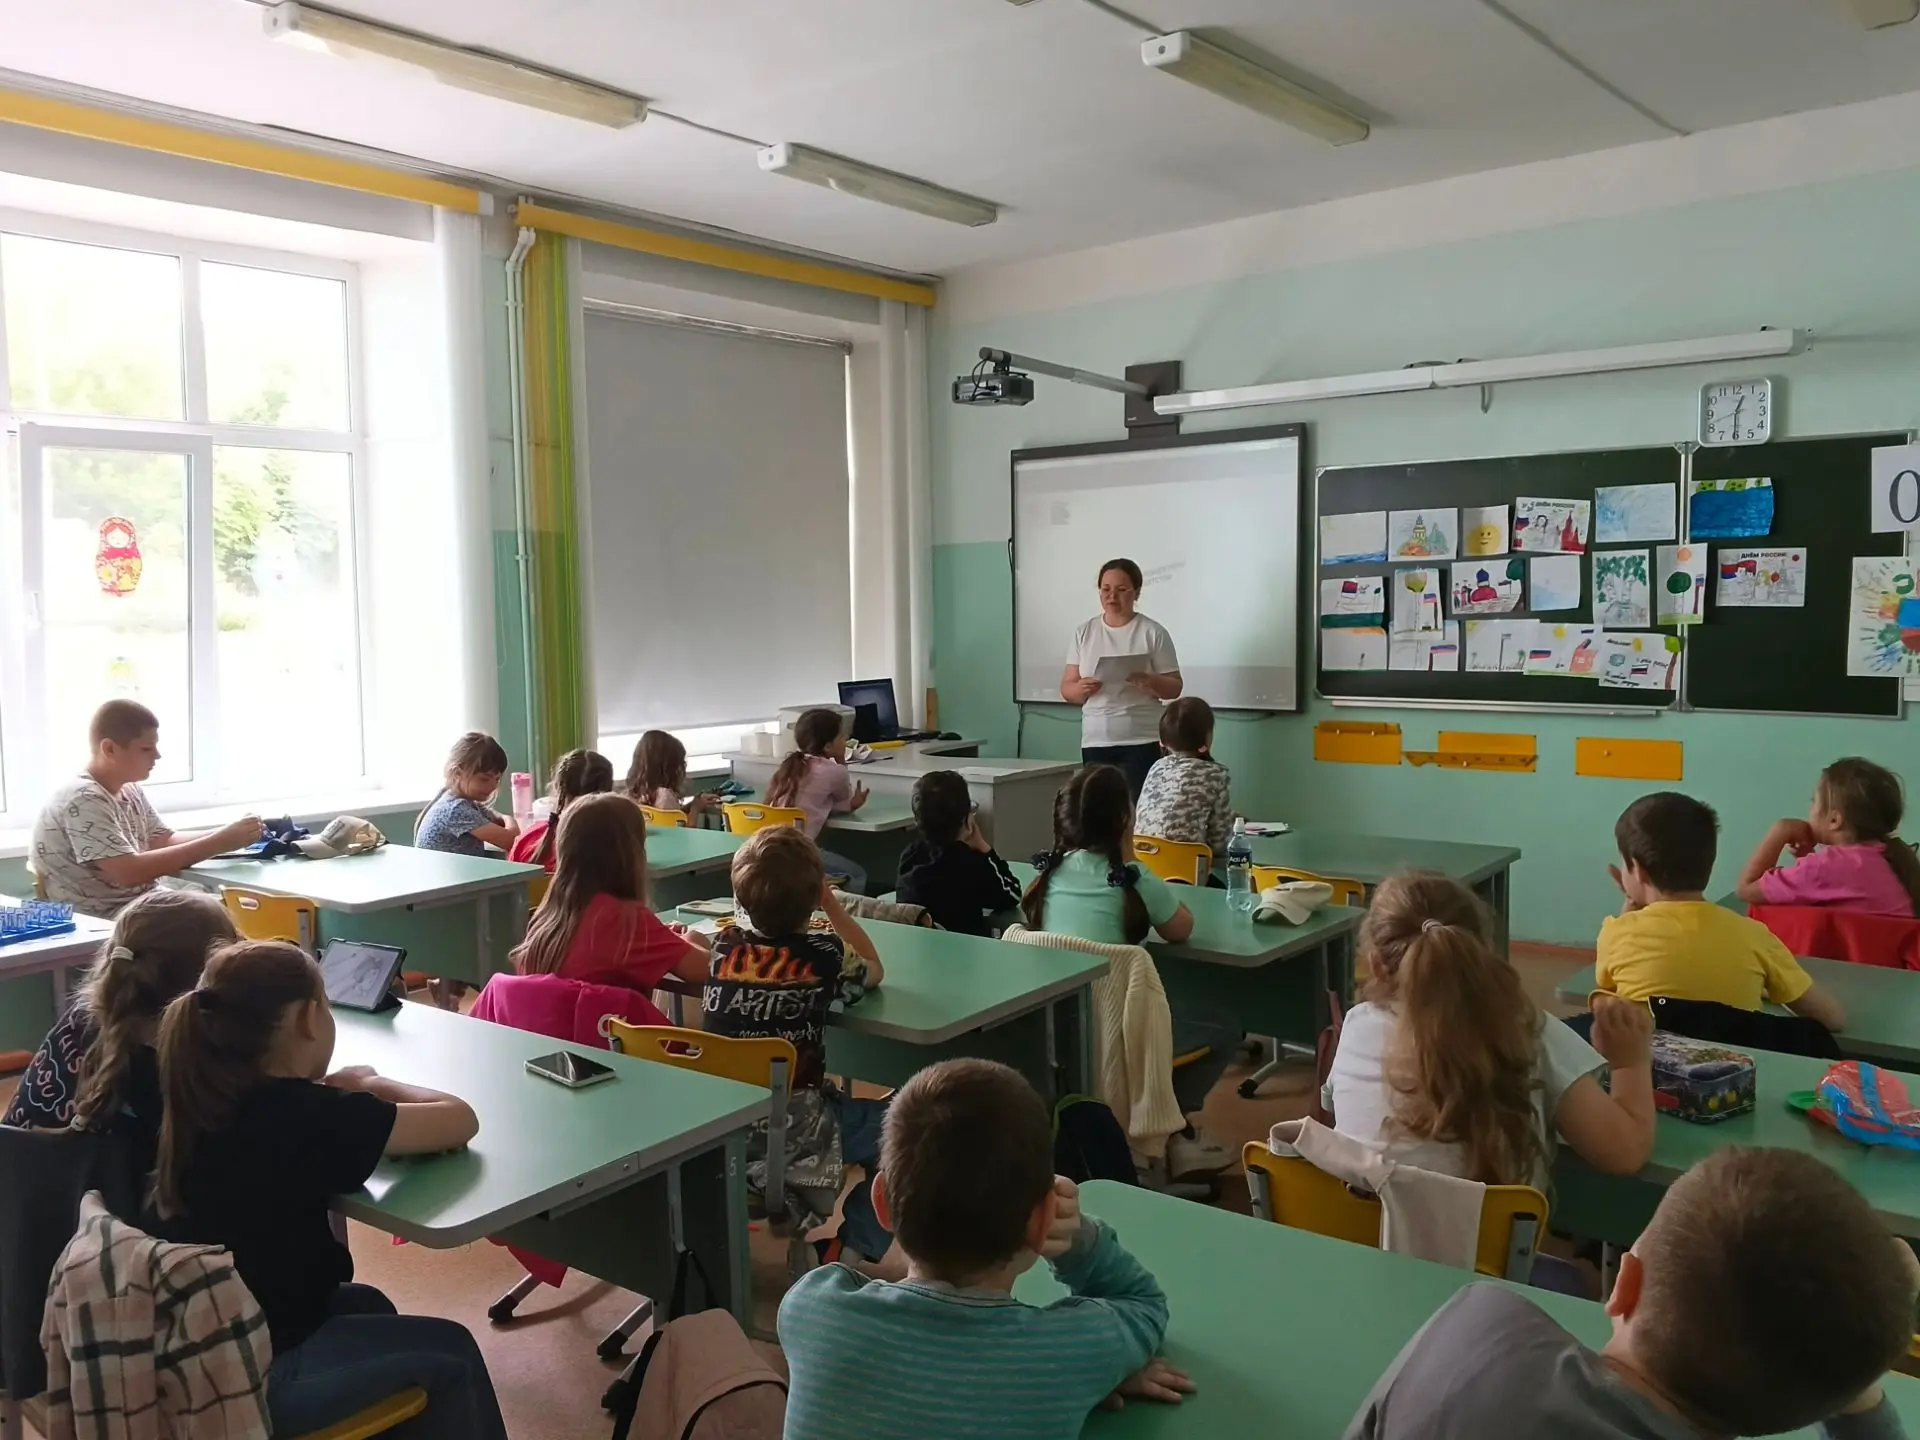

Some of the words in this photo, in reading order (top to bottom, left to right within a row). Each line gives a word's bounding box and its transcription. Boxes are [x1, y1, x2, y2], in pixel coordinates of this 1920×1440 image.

[1719, 387, 1727, 397] 11
[1732, 385, 1743, 396] 12
[1707, 396, 1718, 406] 10
[1758, 391, 1766, 402] 2
[1707, 409, 1714, 421] 9
[1759, 405, 1767, 417] 3
[1707, 423, 1716, 434] 8
[1757, 420, 1765, 430] 4
[1719, 430, 1726, 441] 7
[1747, 429, 1755, 439] 5
